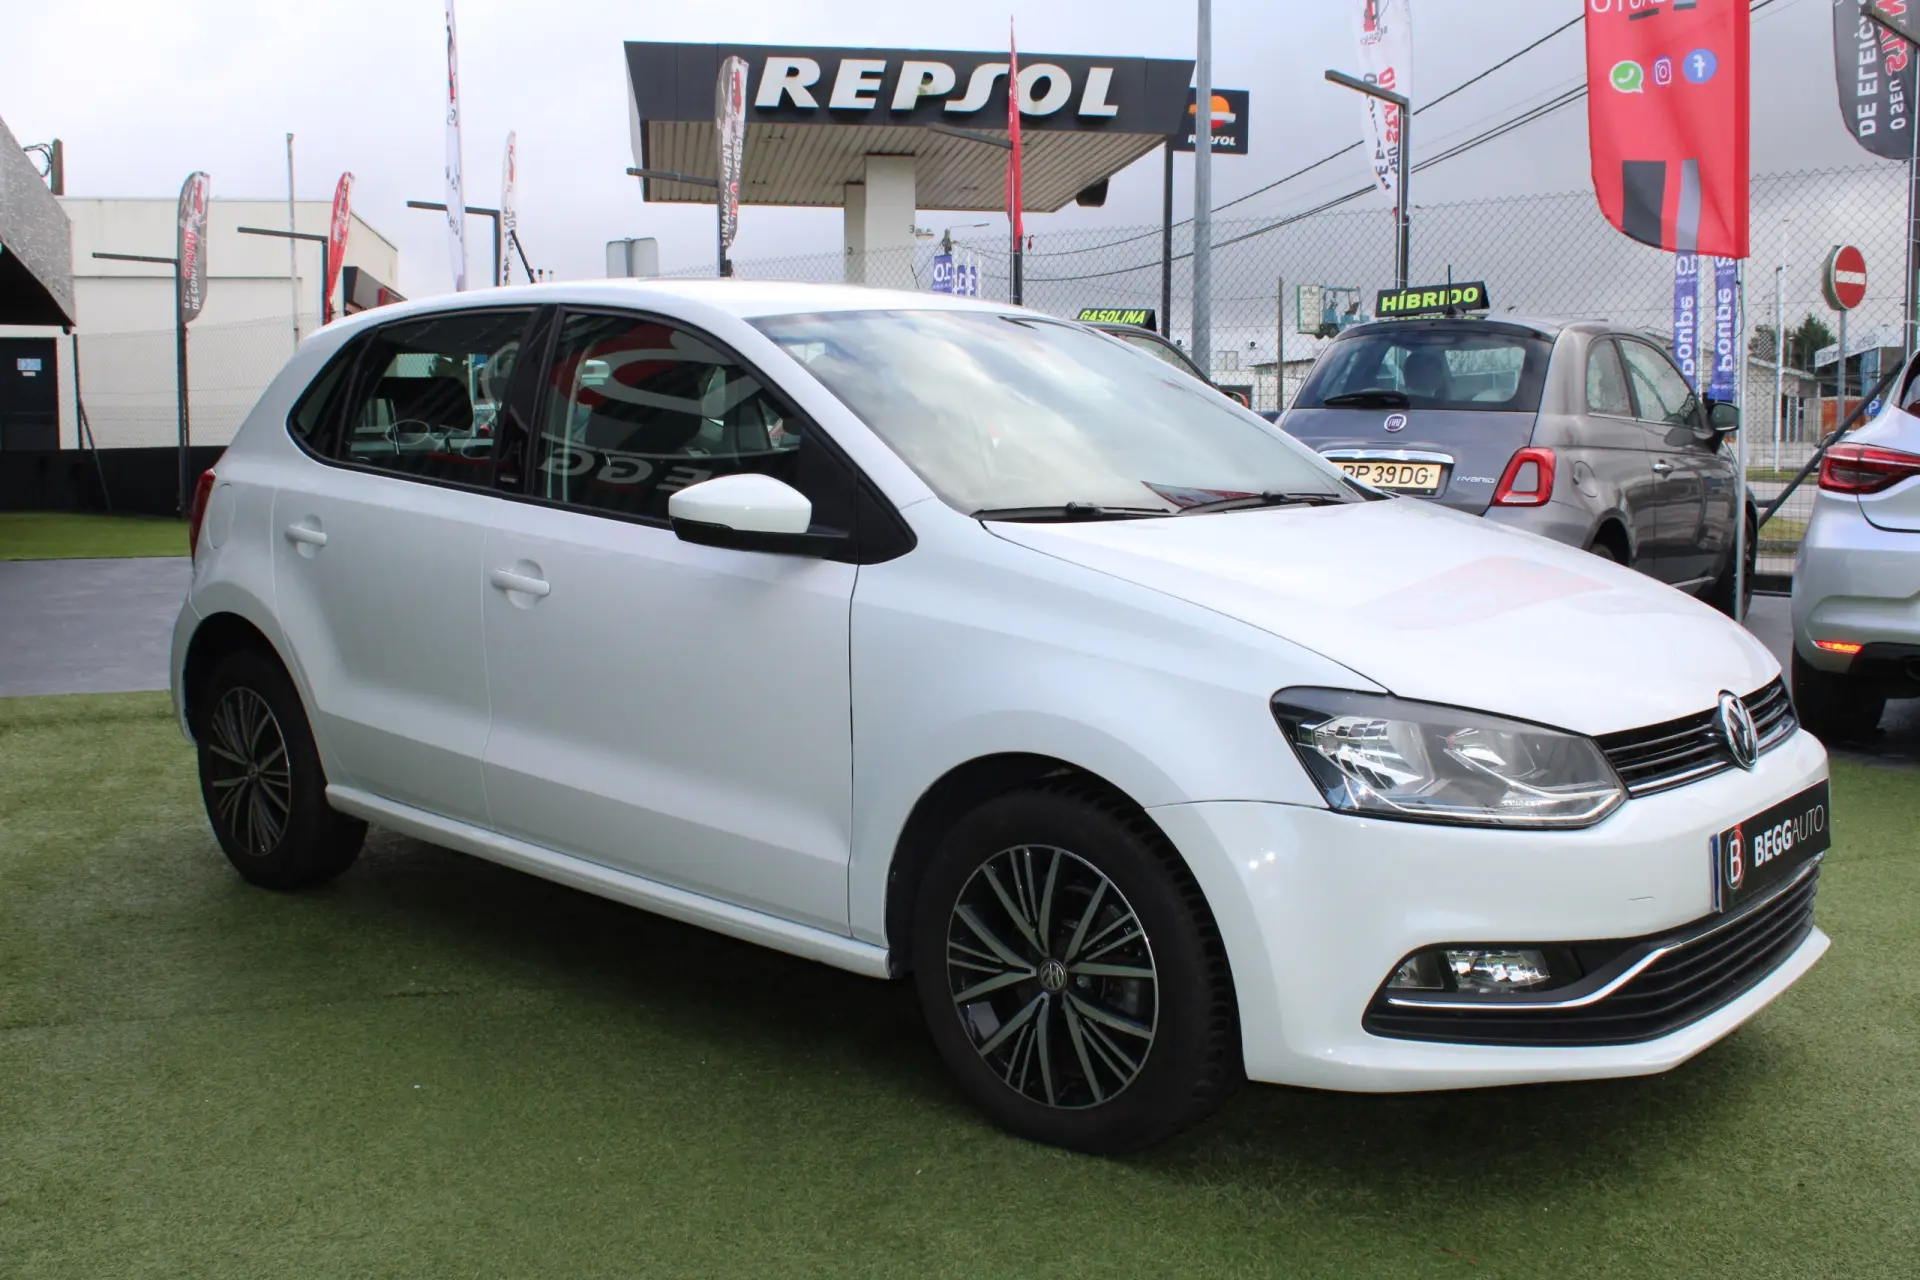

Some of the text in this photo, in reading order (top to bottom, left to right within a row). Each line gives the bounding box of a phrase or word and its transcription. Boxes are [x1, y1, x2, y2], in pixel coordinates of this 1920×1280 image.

[755, 57, 1119, 117] REPSOL
[1381, 287, 1479, 312] HÍBRIDO
[1080, 309, 1147, 323] GASOLINA
[1372, 466, 1396, 484] 39
[1398, 467, 1429, 485] DG
